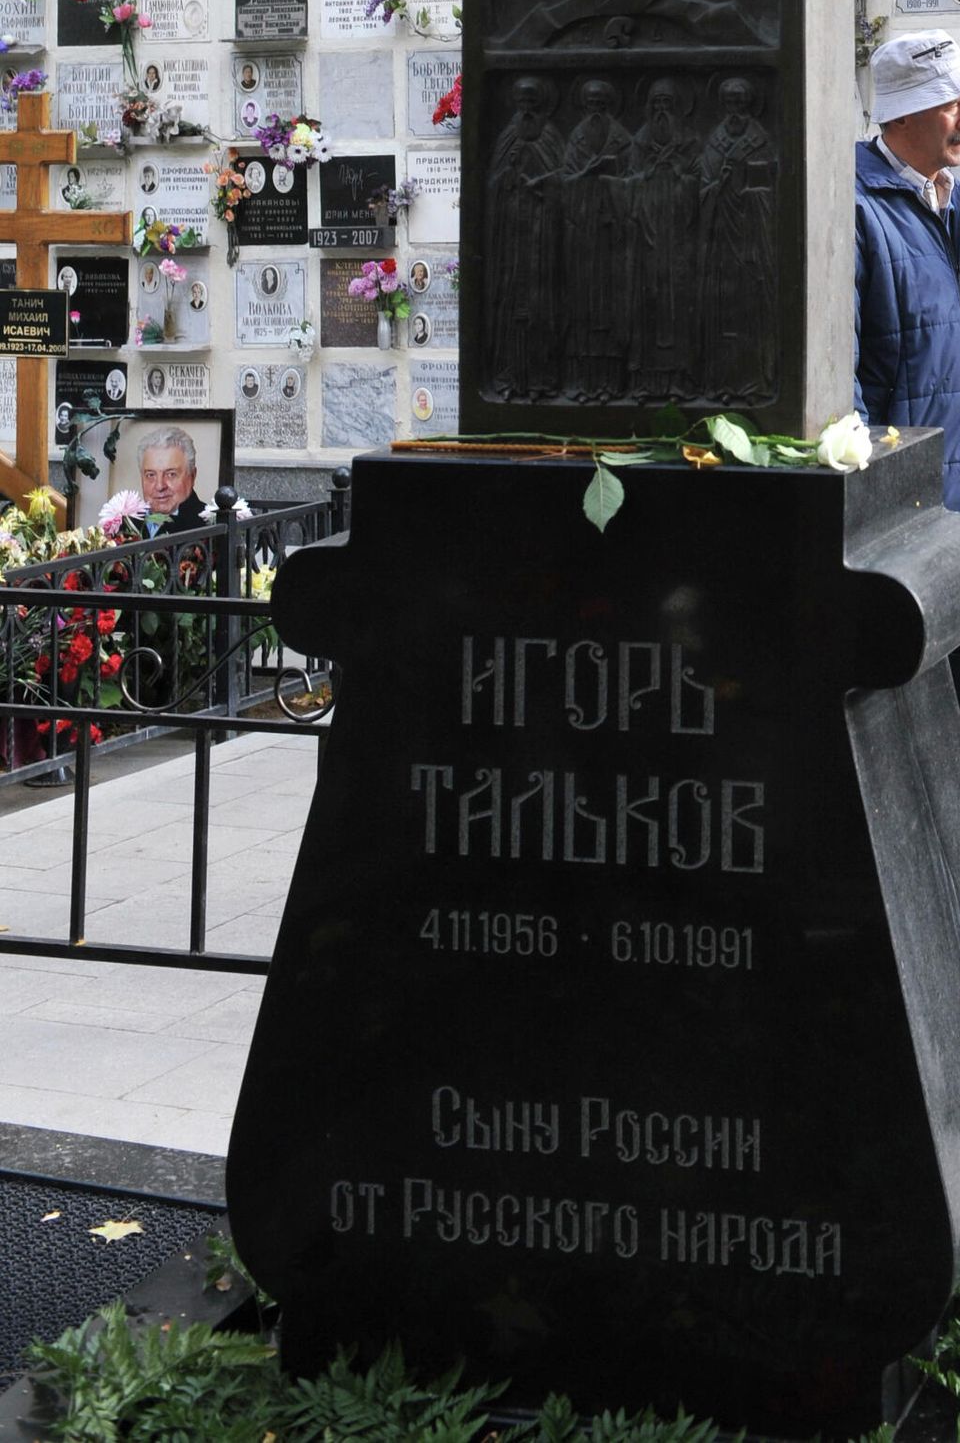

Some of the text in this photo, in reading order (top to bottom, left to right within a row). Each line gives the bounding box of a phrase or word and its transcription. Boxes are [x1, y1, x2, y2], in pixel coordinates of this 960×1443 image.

[412, 61, 462, 76] БОБОРЫК
[416, 157, 457, 165] ПРУДКИН
[313, 230, 379, 246] 1923 2007
[12, 298, 44, 308] ТАНИЧ
[248, 302, 292, 316] ВОЛКОВА
[9, 312, 48, 322] МИХАИЛ
[3, 325, 51, 336] ИСАЕВИЧ
[168, 365, 206, 378] СЕКАЧЕВ
[420, 363, 458, 371] ФРОЛО
[461, 635, 716, 735] ИГОРЬ
[410, 763, 765, 874] ТАЛЬКОВ
[418, 908, 753, 970] 4.11.1956 6.10.1991
[431, 1084, 761, 1172] Сыну России
[329, 1177, 842, 1279] от Русского народа
